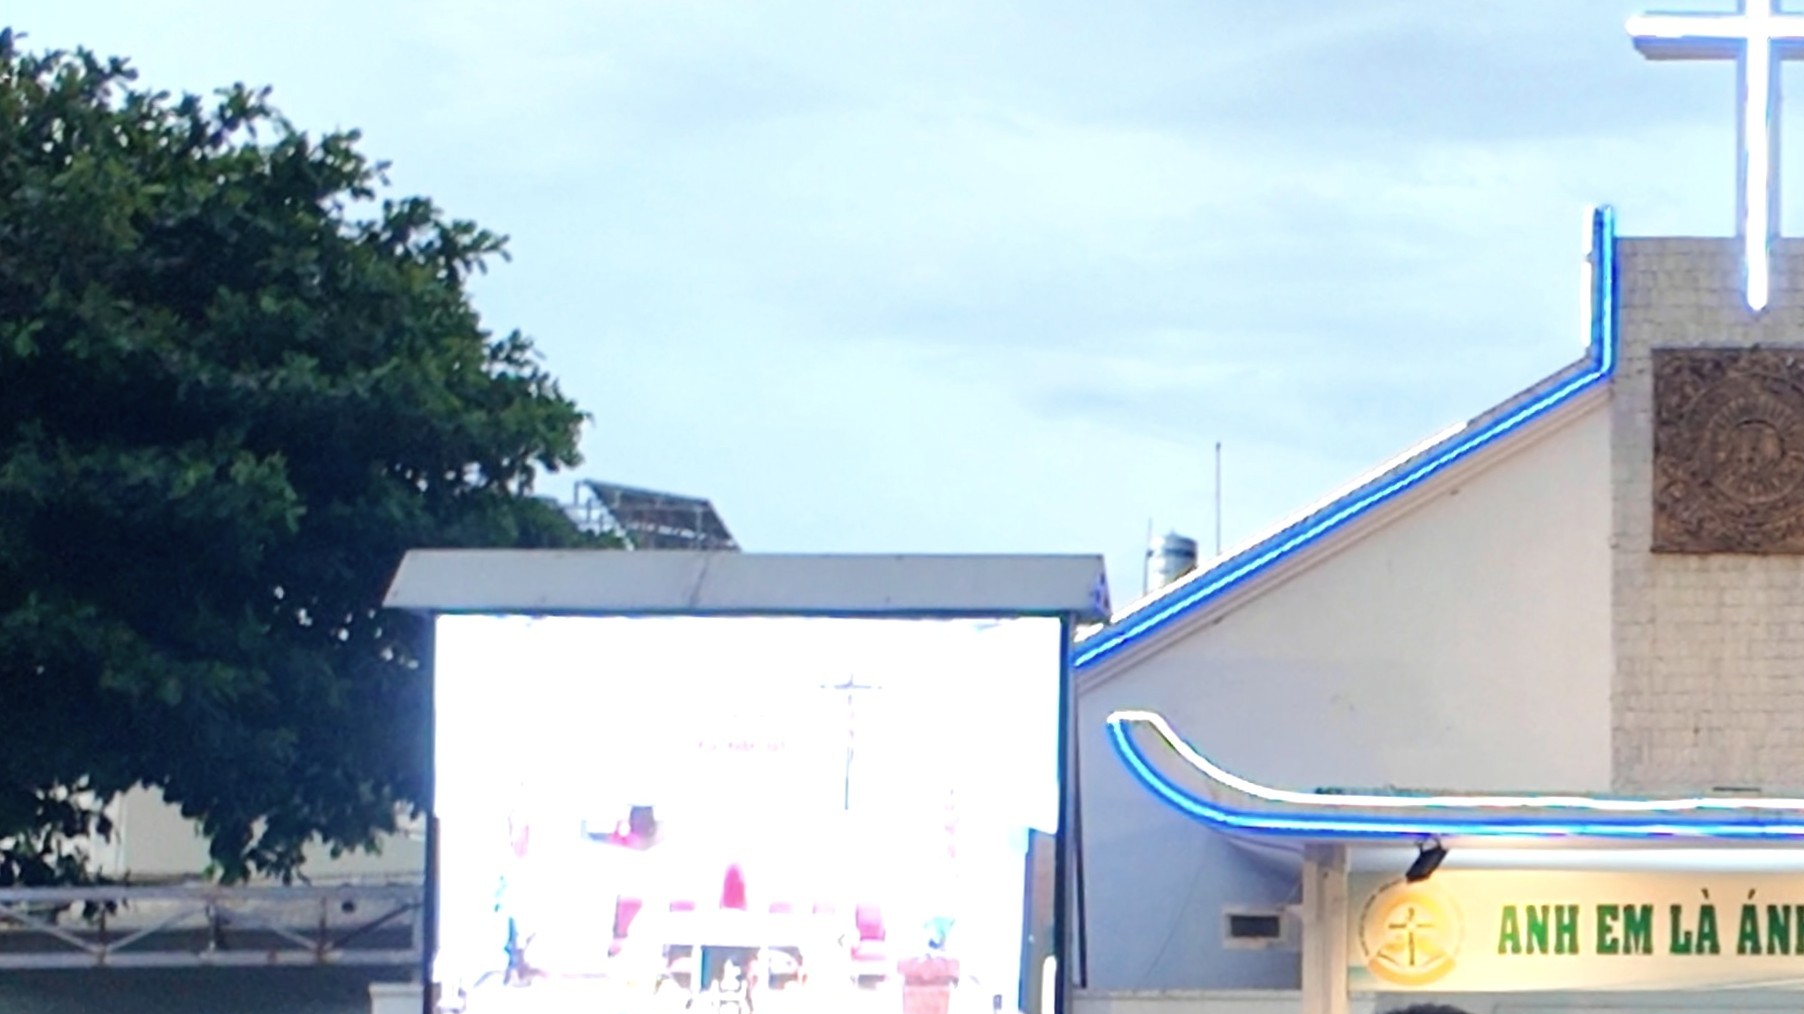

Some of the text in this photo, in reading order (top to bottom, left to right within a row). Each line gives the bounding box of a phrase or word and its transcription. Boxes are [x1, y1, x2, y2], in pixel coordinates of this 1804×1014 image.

[1497, 903, 1580, 956] ANH
[1595, 903, 1655, 956] EM
[1669, 888, 1721, 956] LÀ
